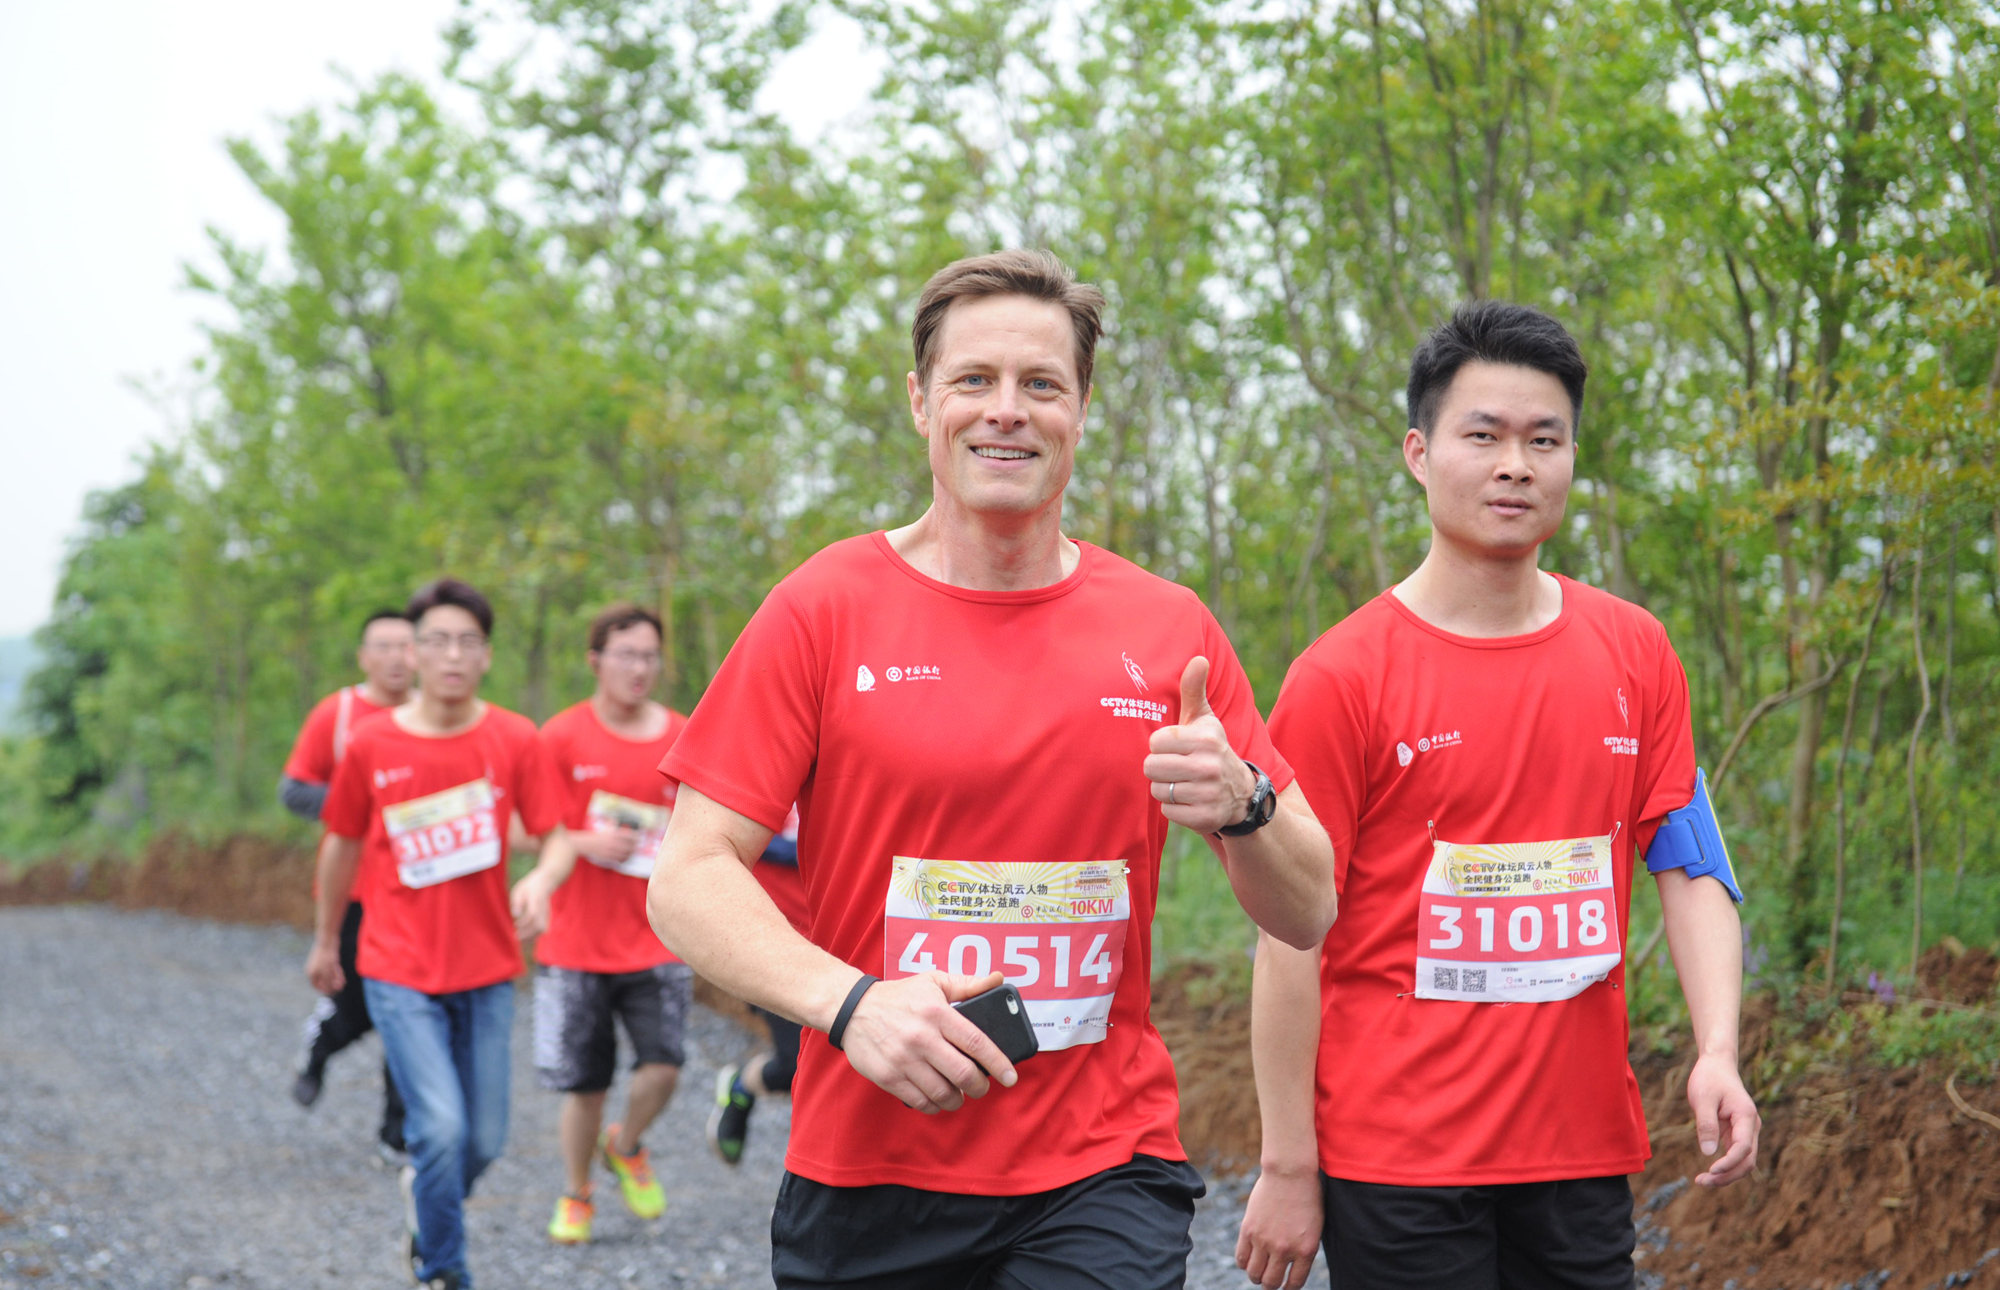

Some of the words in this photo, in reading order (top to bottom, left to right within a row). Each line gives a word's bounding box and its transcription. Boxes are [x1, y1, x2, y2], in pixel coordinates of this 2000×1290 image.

[905, 665, 940, 676] 中国银行
[1464, 873, 1531, 885] 全民健身公益跑
[1567, 868, 1599, 885] 10KM
[938, 881, 1048, 895] CCTV体坛风云人物
[938, 895, 1020, 909] 全民健身公益跑
[1069, 898, 1113, 915] 10KM
[1429, 899, 1607, 953] 31018
[899, 932, 1112, 987] 40514
